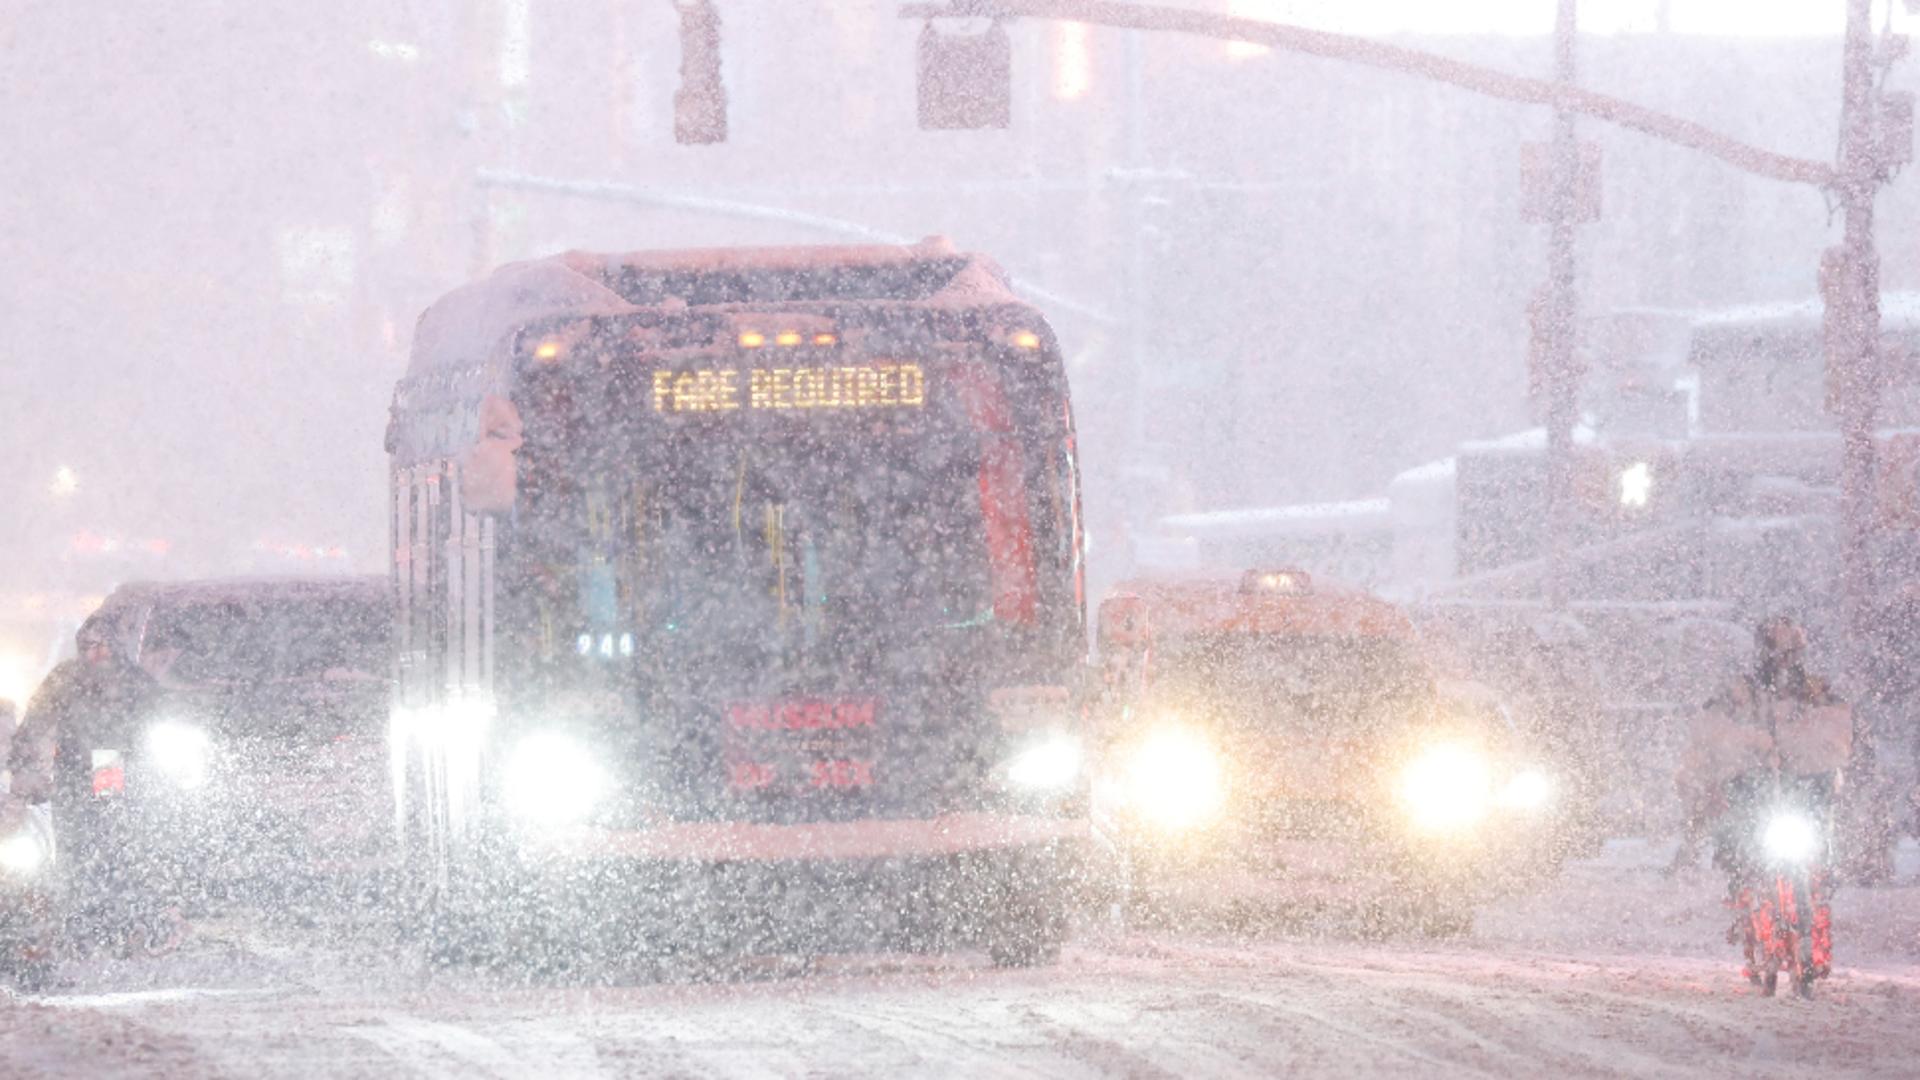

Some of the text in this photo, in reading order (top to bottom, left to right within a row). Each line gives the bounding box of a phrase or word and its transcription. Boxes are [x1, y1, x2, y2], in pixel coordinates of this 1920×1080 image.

[654, 364, 923, 411] FARE REQUIRED
[730, 703, 876, 730] MUSEUM
[812, 760, 876, 786] SEX
